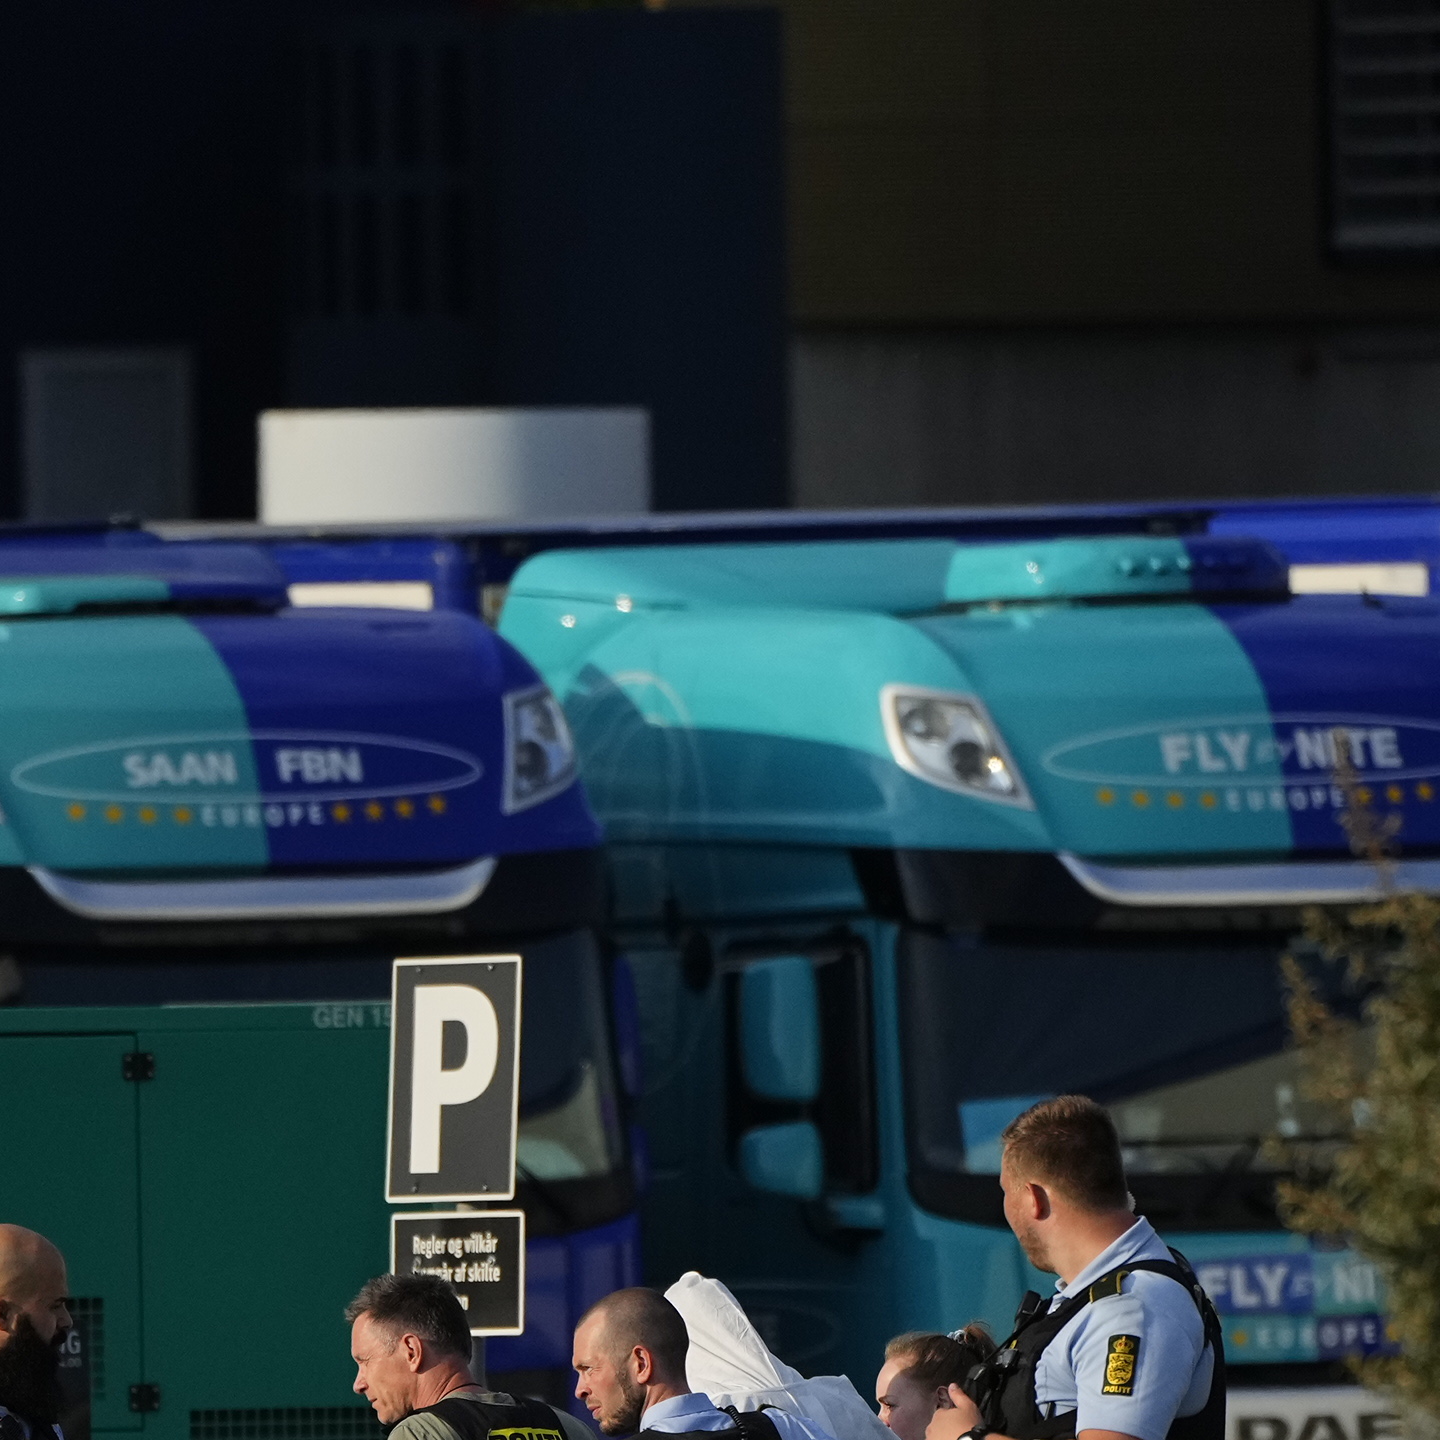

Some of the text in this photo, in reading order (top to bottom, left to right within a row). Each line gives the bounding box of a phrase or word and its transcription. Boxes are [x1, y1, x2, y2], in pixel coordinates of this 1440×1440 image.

[1161, 730, 1250, 774] FLY
[1293, 727, 1404, 769] NITE
[123, 747, 363, 788] SAAN FBN
[201, 801, 326, 828] EUROPE
[313, 1003, 392, 1029] GEN 15
[409, 984, 499, 1174] P
[412, 1231, 499, 1259] Regler og vilkår
[454, 1261, 467, 1283] af
[1201, 1262, 1289, 1307] FLY
[1255, 1318, 1379, 1348] EUROPE
[1103, 1385, 1132, 1395] POLITI
